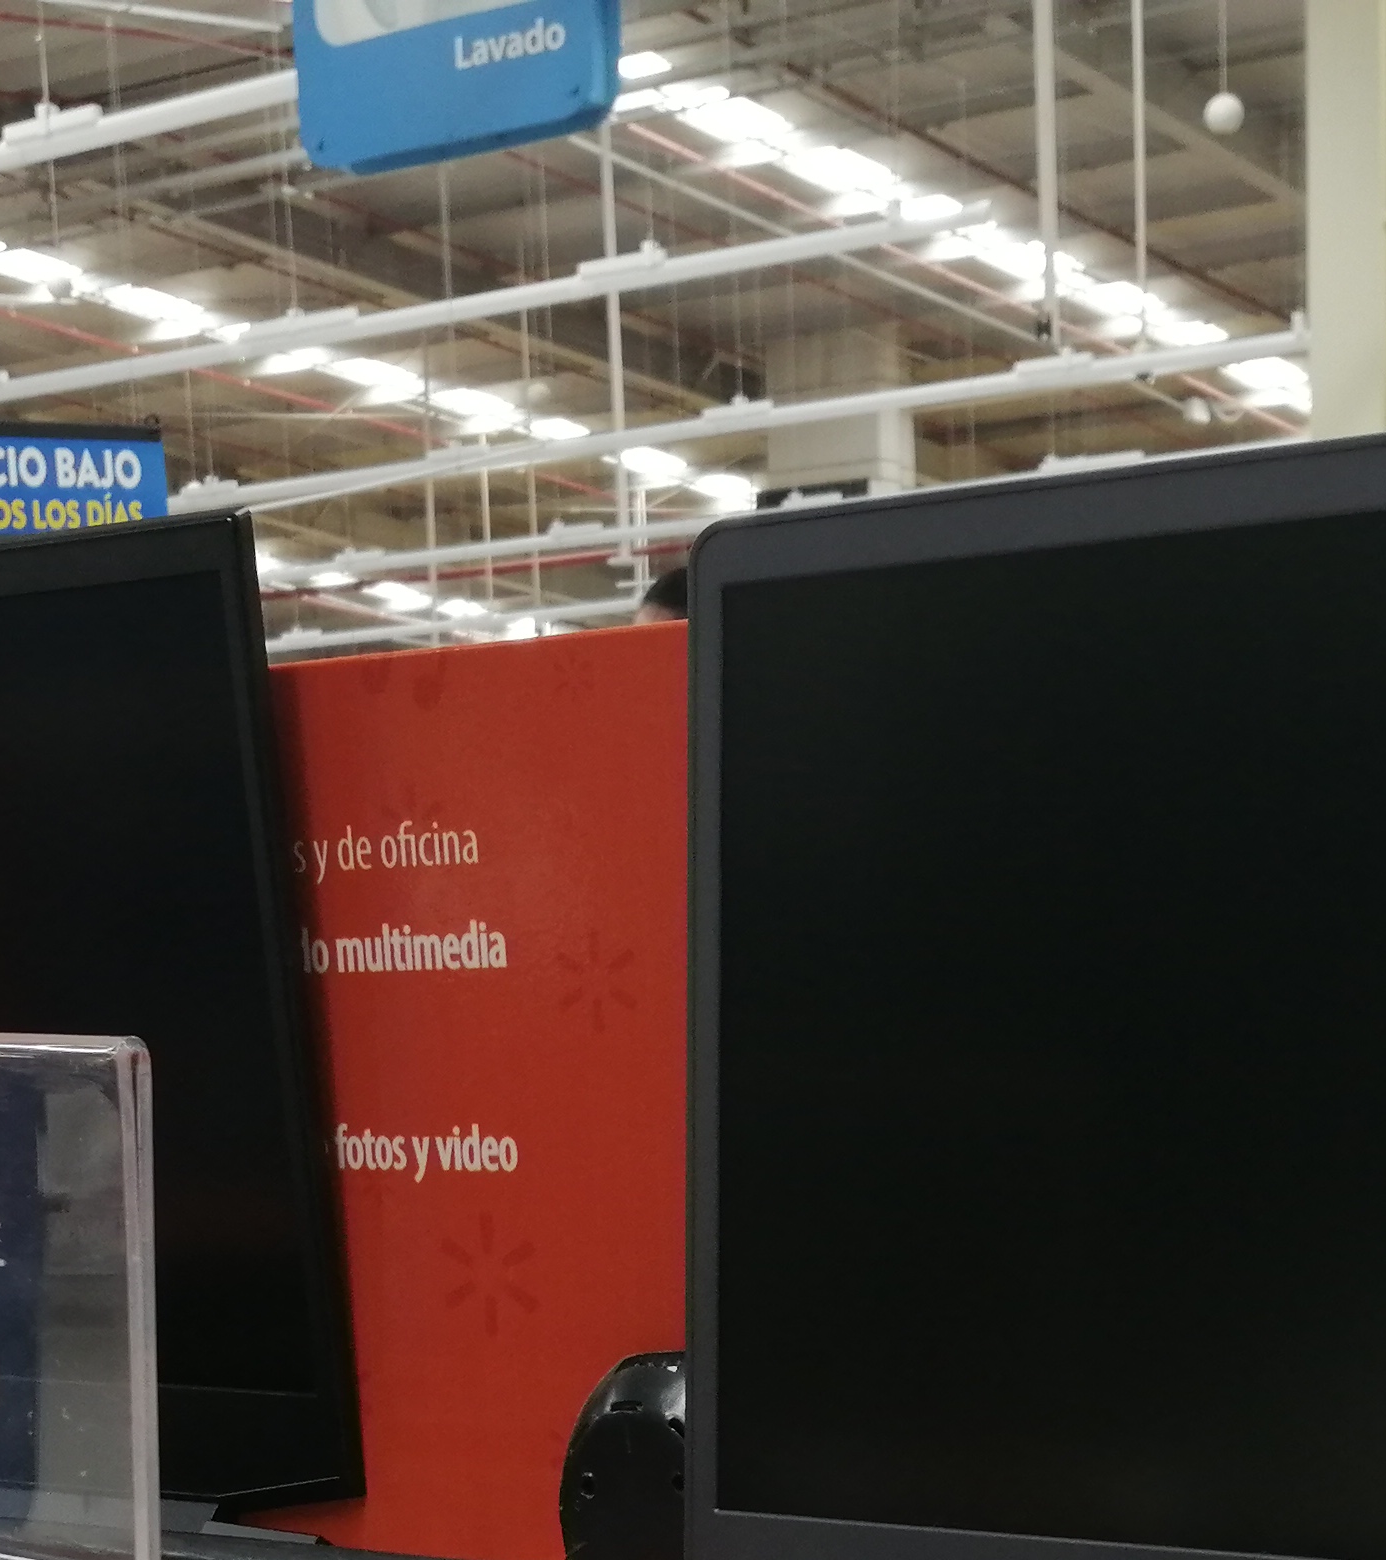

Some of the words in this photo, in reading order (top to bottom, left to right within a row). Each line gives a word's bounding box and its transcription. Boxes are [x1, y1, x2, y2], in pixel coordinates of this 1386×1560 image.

[455, 16, 566, 70] Lavado
[54, 447, 142, 489] BAJO
[33, 500, 81, 530] LOS
[86, 492, 143, 528] DÍAS
[313, 838, 327, 884] y
[337, 825, 372, 871] de
[380, 821, 480, 868] oficina
[335, 919, 507, 973] multimedia
[335, 1123, 407, 1171] fotos
[411, 1136, 429, 1183] y
[435, 1123, 518, 1172] video
